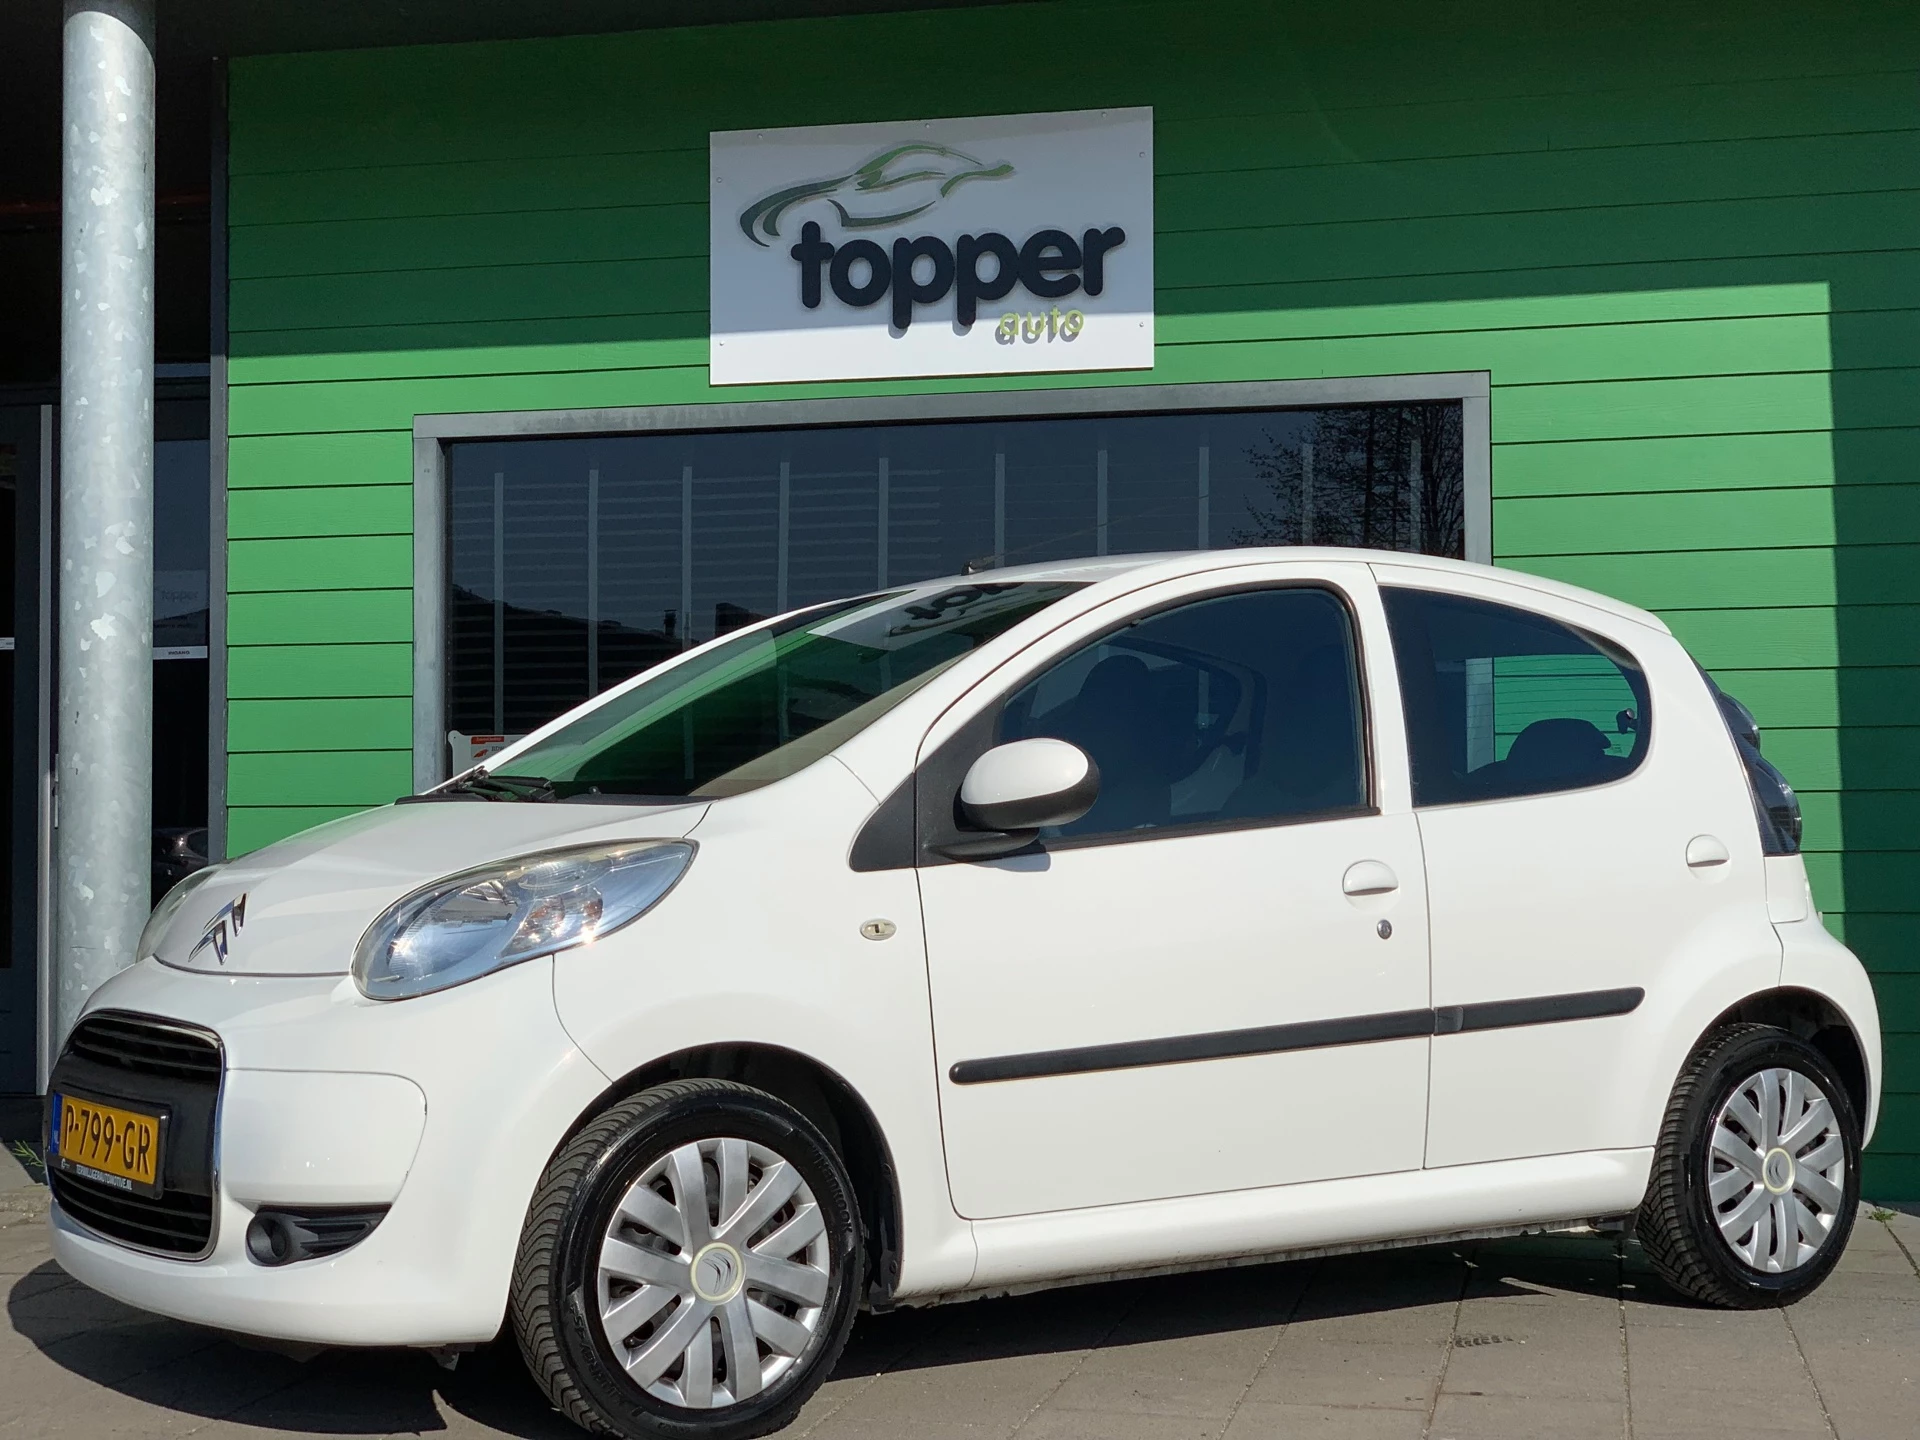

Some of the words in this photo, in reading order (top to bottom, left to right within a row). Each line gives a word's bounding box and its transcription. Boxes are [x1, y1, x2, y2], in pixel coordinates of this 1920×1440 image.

[790, 220, 1126, 329] topper
[1000, 306, 1084, 336] auto
[64, 1104, 151, 1176] P-799-GR
